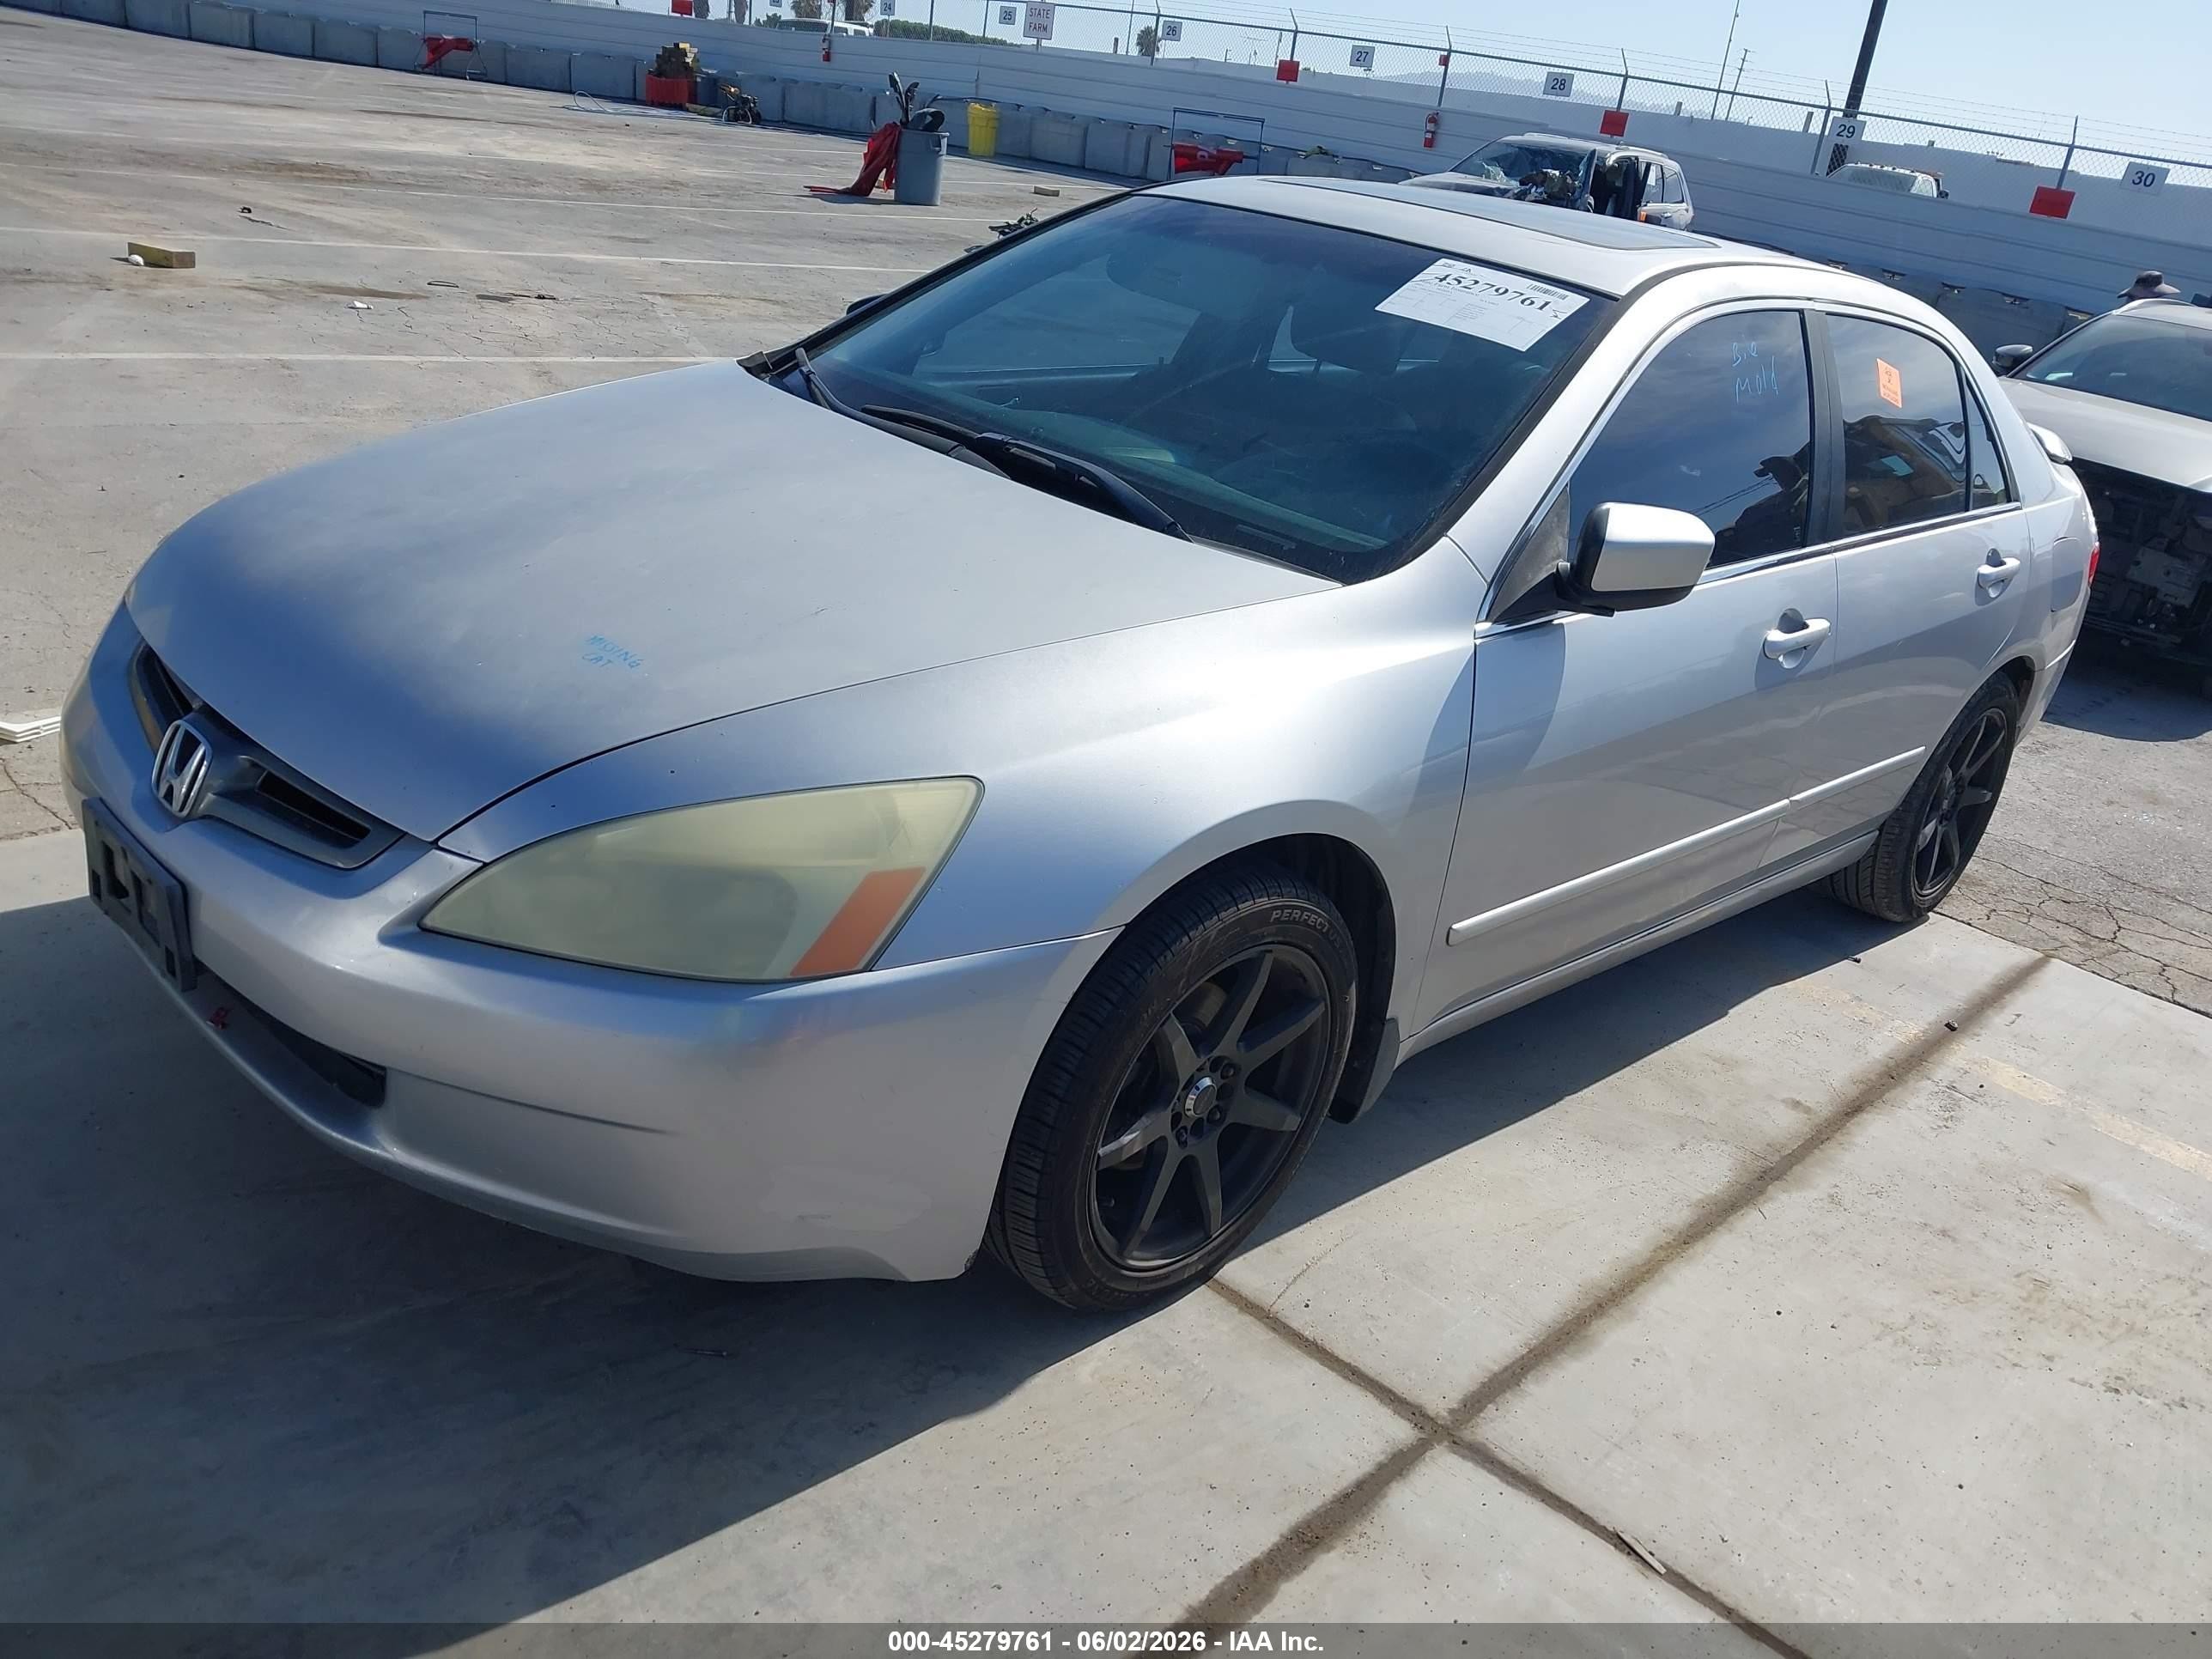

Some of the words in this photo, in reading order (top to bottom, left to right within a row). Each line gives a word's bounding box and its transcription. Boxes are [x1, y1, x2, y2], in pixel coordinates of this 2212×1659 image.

[884, 2, 892, 12] 24
[1003, 10, 1012, 21] 25
[1029, 8, 1050, 19] STATE
[1029, 22, 1048, 33] FARM
[1166, 25, 1177, 36] 26
[1356, 51, 1369, 62] 27
[1551, 77, 1566, 91] 28
[1836, 124, 1856, 138] 29
[2131, 170, 2155, 187] 30
[1434, 272, 1553, 311] 45279761
